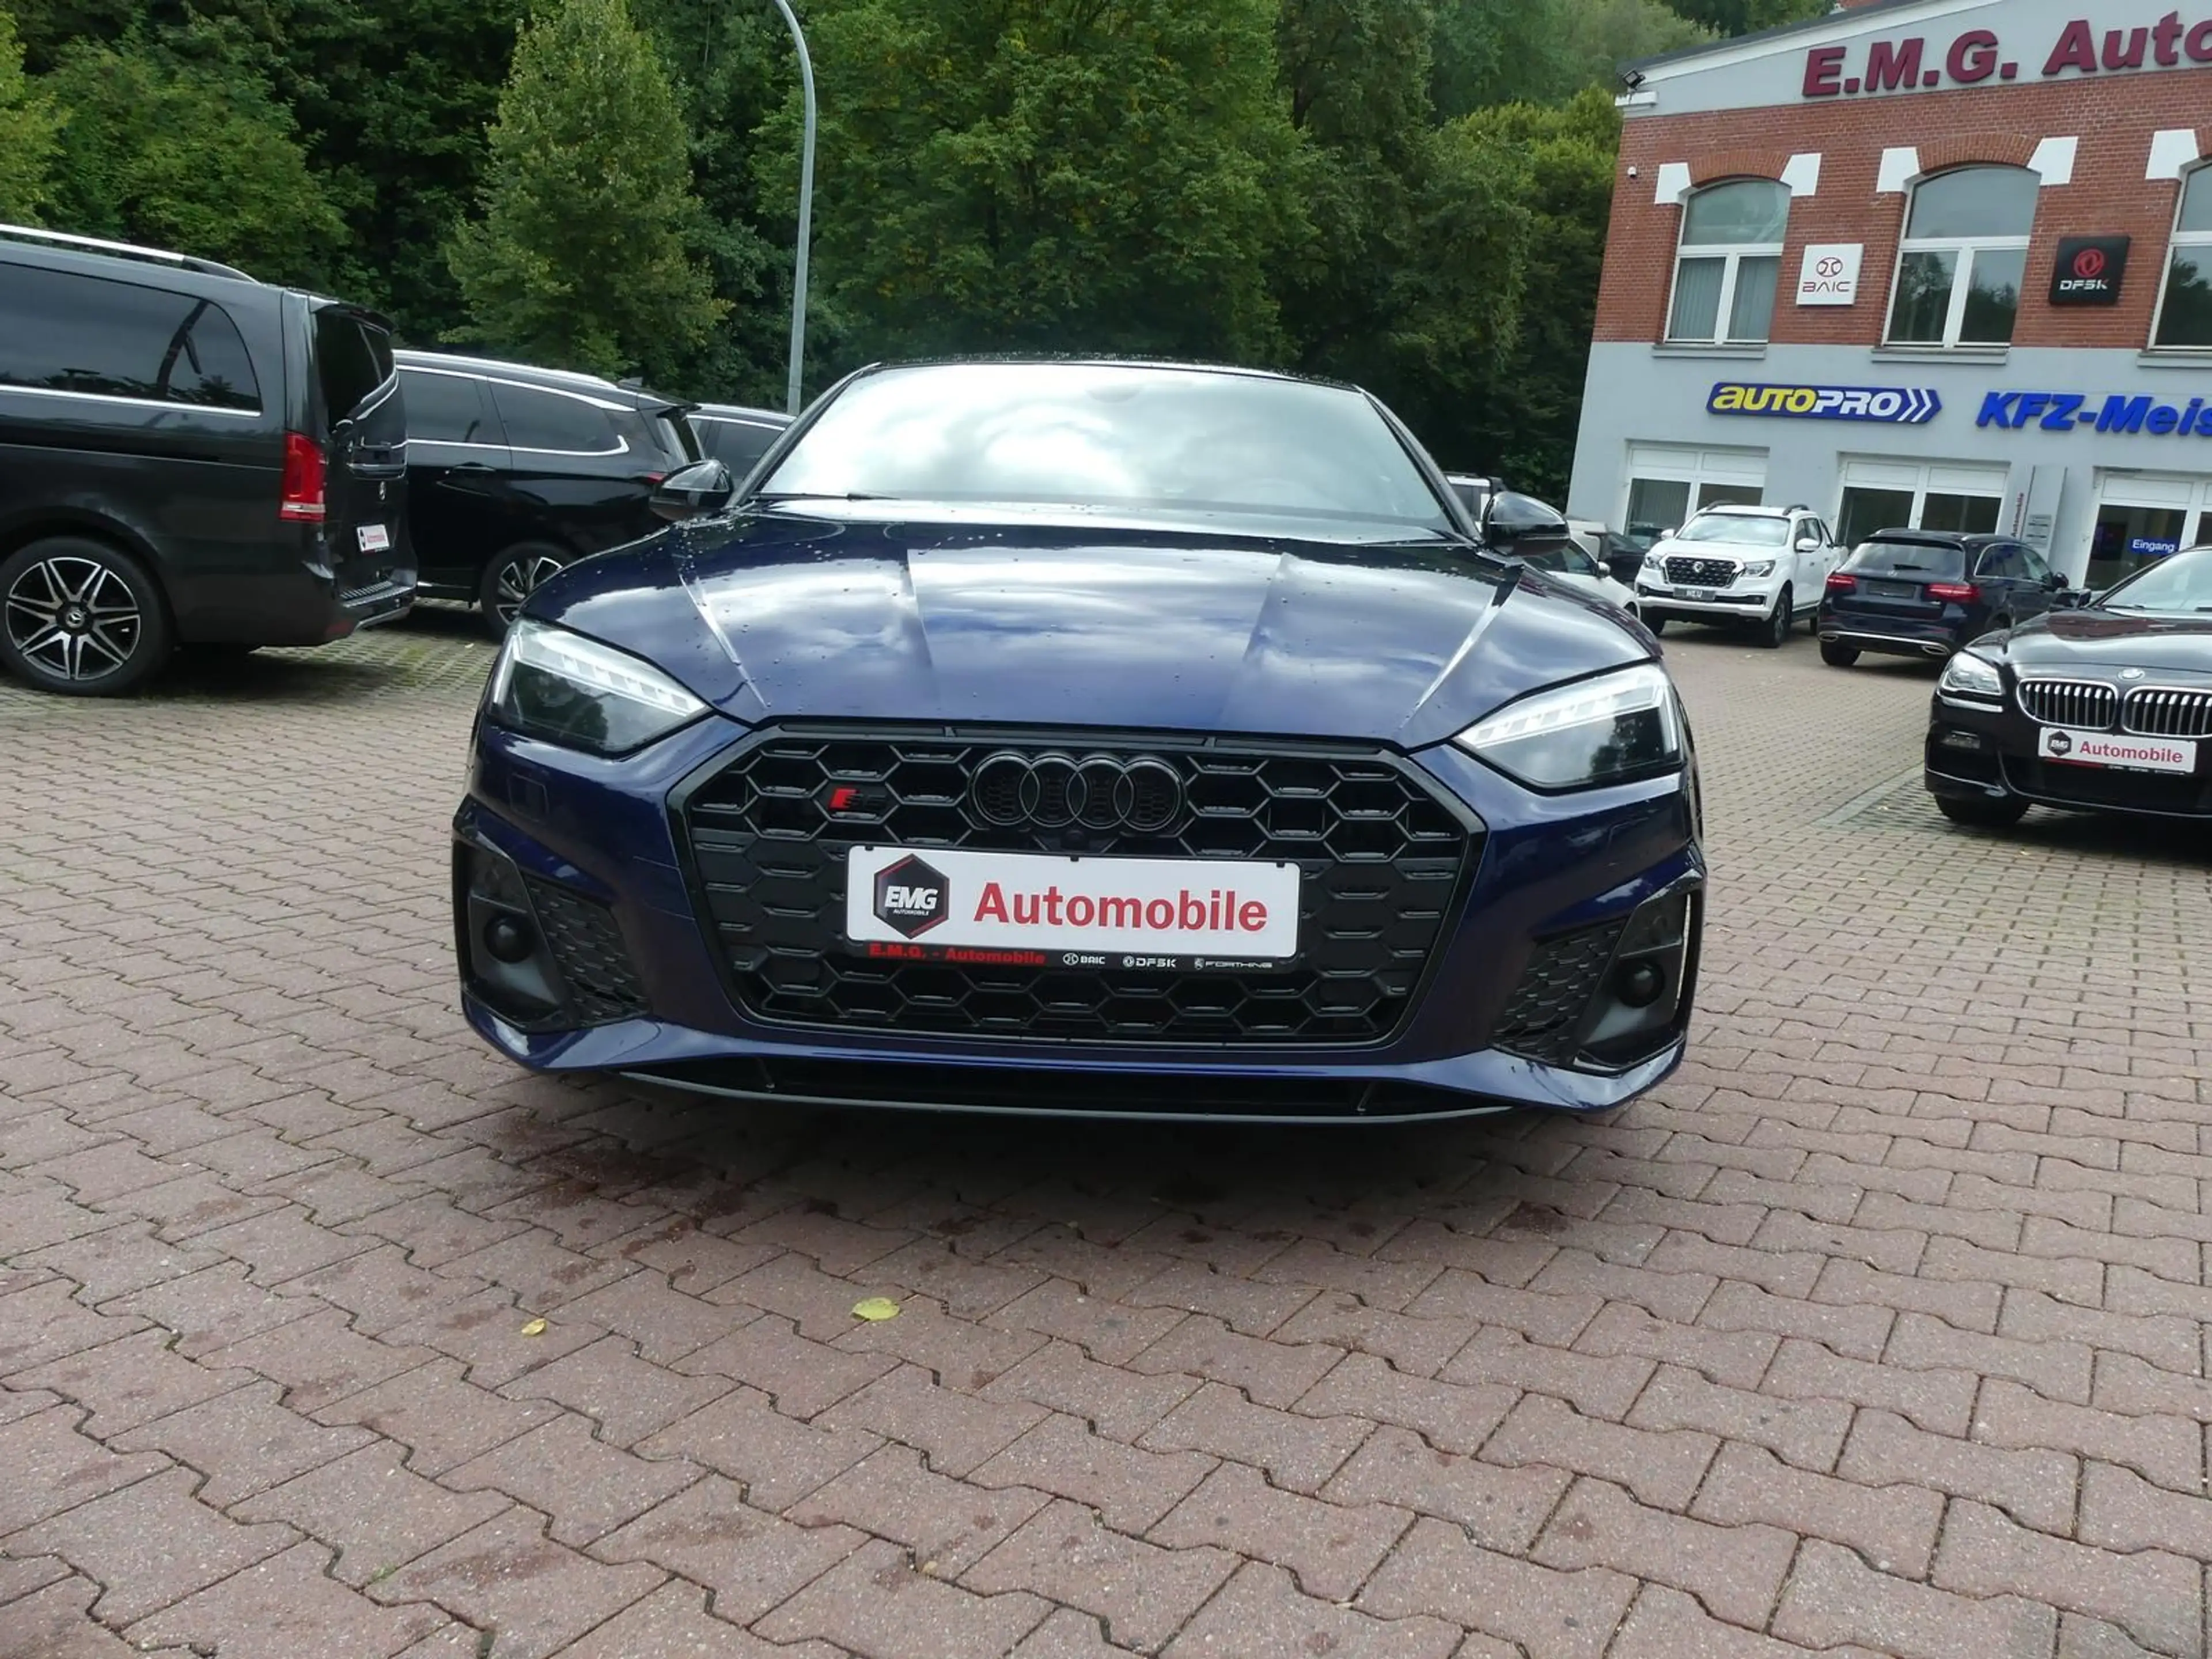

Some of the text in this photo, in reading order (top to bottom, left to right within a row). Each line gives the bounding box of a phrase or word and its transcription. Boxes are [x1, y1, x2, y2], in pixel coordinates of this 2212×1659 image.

[1802, 29, 2018, 96] E.M.G.
[1802, 280, 1851, 293] BAIC
[2059, 279, 2109, 291] DFSK
[2132, 539, 2176, 553] Eingang
[2079, 741, 2184, 763] Automobile
[885, 885, 939, 910] EMG
[974, 882, 1269, 932] Automobile
[945, 947, 1046, 964] Automobile
[1080, 955, 1105, 965] BAIC
[1135, 957, 1177, 968] DFSK
